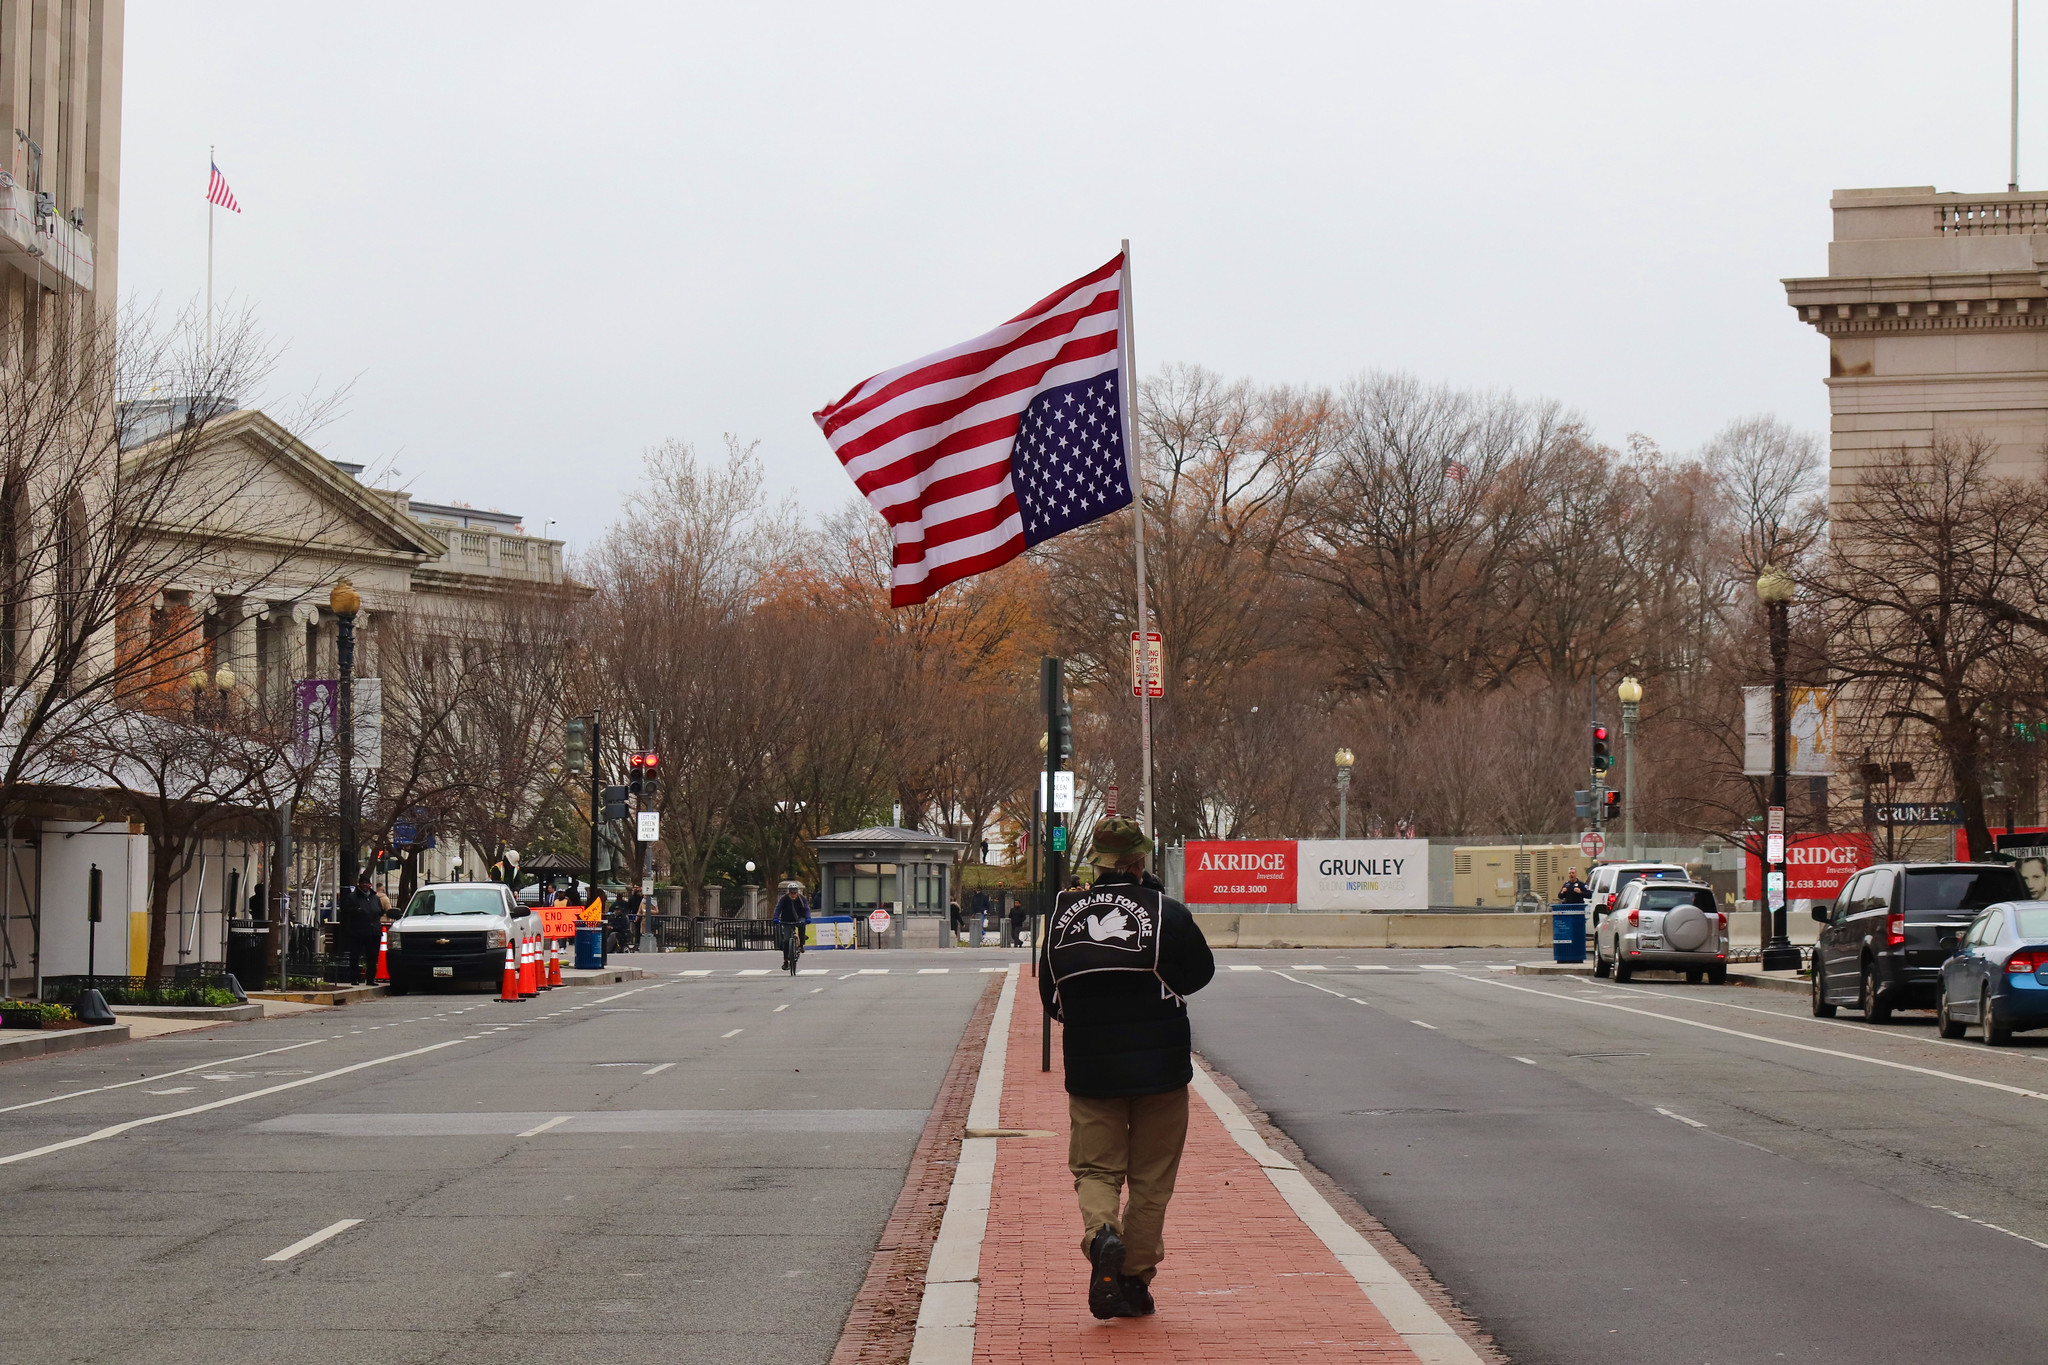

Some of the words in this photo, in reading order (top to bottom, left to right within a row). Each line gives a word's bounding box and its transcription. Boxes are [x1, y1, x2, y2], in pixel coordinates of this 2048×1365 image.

[1877, 807, 1949, 821] GRUNLEY
[1198, 852, 1285, 870] AKRIDGE
[1320, 858, 1404, 876] GRUNLEY
[1213, 885, 1267, 894] 202.638.3000
[1320, 881, 1345, 891] BUILDING
[1346, 881, 1378, 890] INSPIRING
[1381, 881, 1405, 890] SPACES
[545, 912, 562, 920] END
[1055, 893, 1113, 929] VETERANS
[1115, 894, 1138, 912] FOR
[1134, 906, 1153, 937] PEACE
[555, 923, 573, 932] WOR
